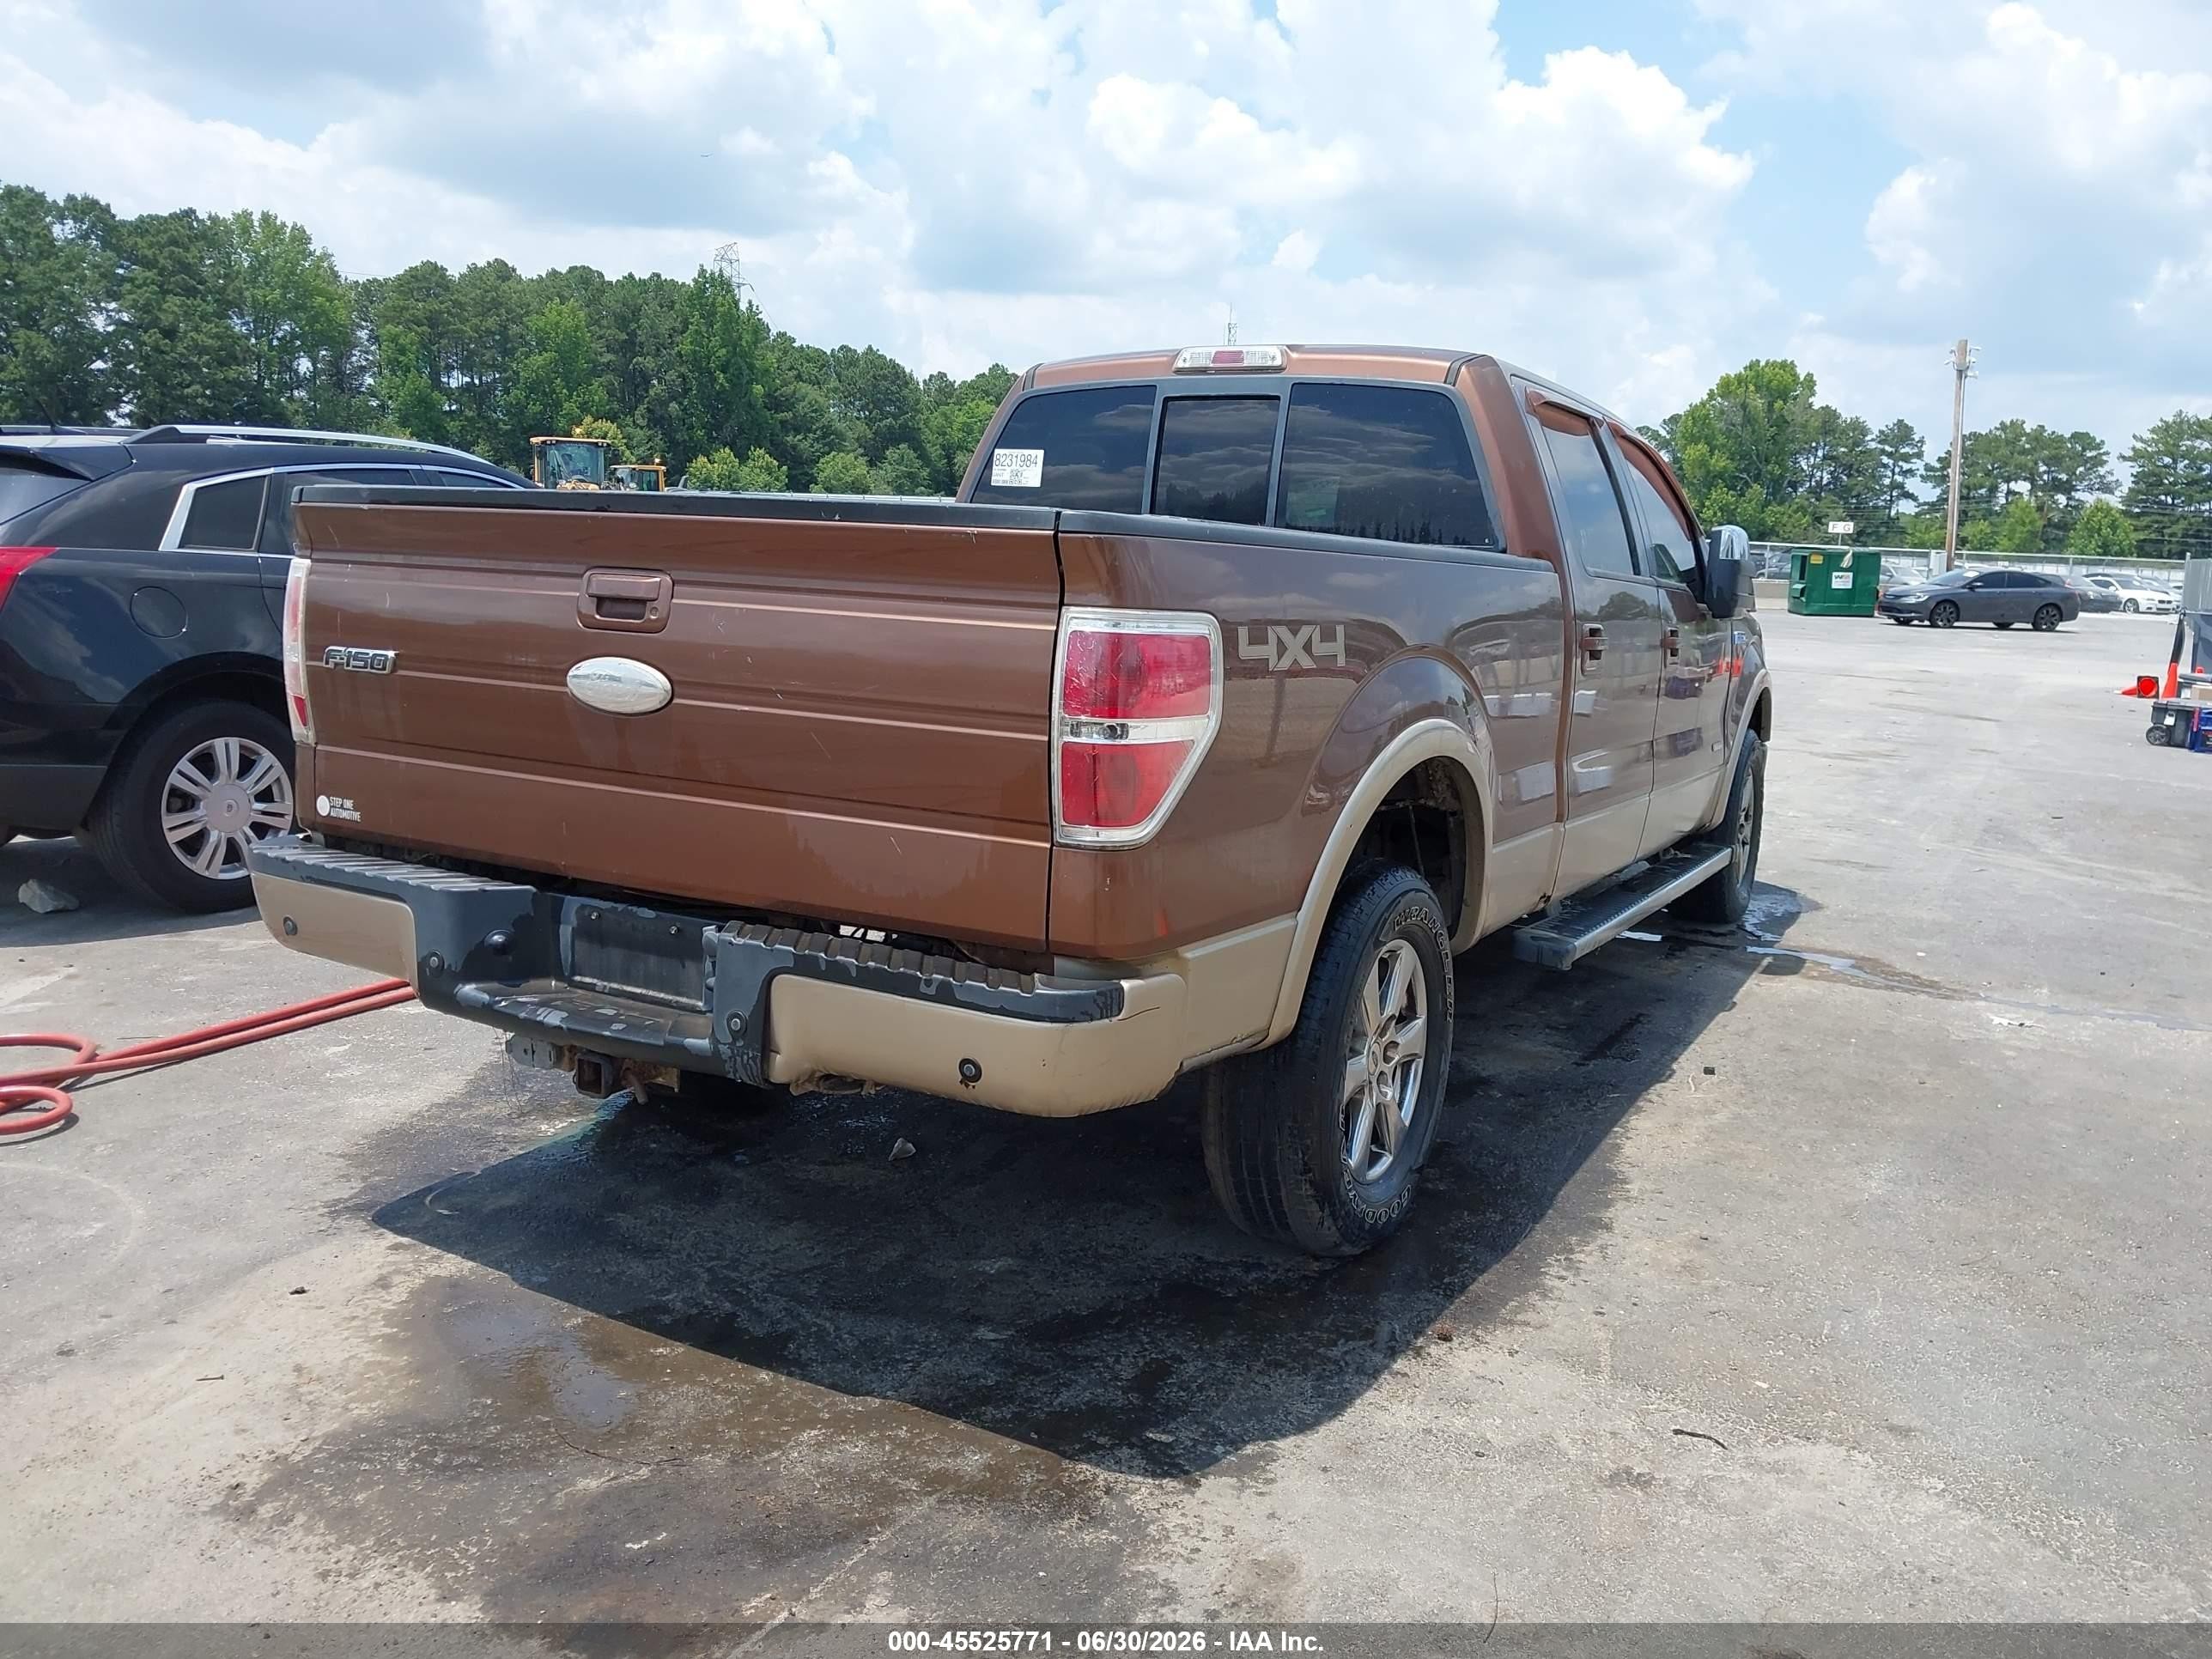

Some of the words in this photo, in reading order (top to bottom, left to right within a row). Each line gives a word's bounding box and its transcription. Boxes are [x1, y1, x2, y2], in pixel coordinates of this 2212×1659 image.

[994, 453, 1038, 468] 8231984
[1832, 523, 1838, 532] F
[1843, 523, 1851, 532] G
[1237, 624, 1346, 672] 4X4
[330, 796, 343, 808] STEP
[343, 798, 355, 810] ONE
[330, 807, 362, 823] AUTOMOTIVE
[1393, 906, 1455, 1024] WRANGLER
